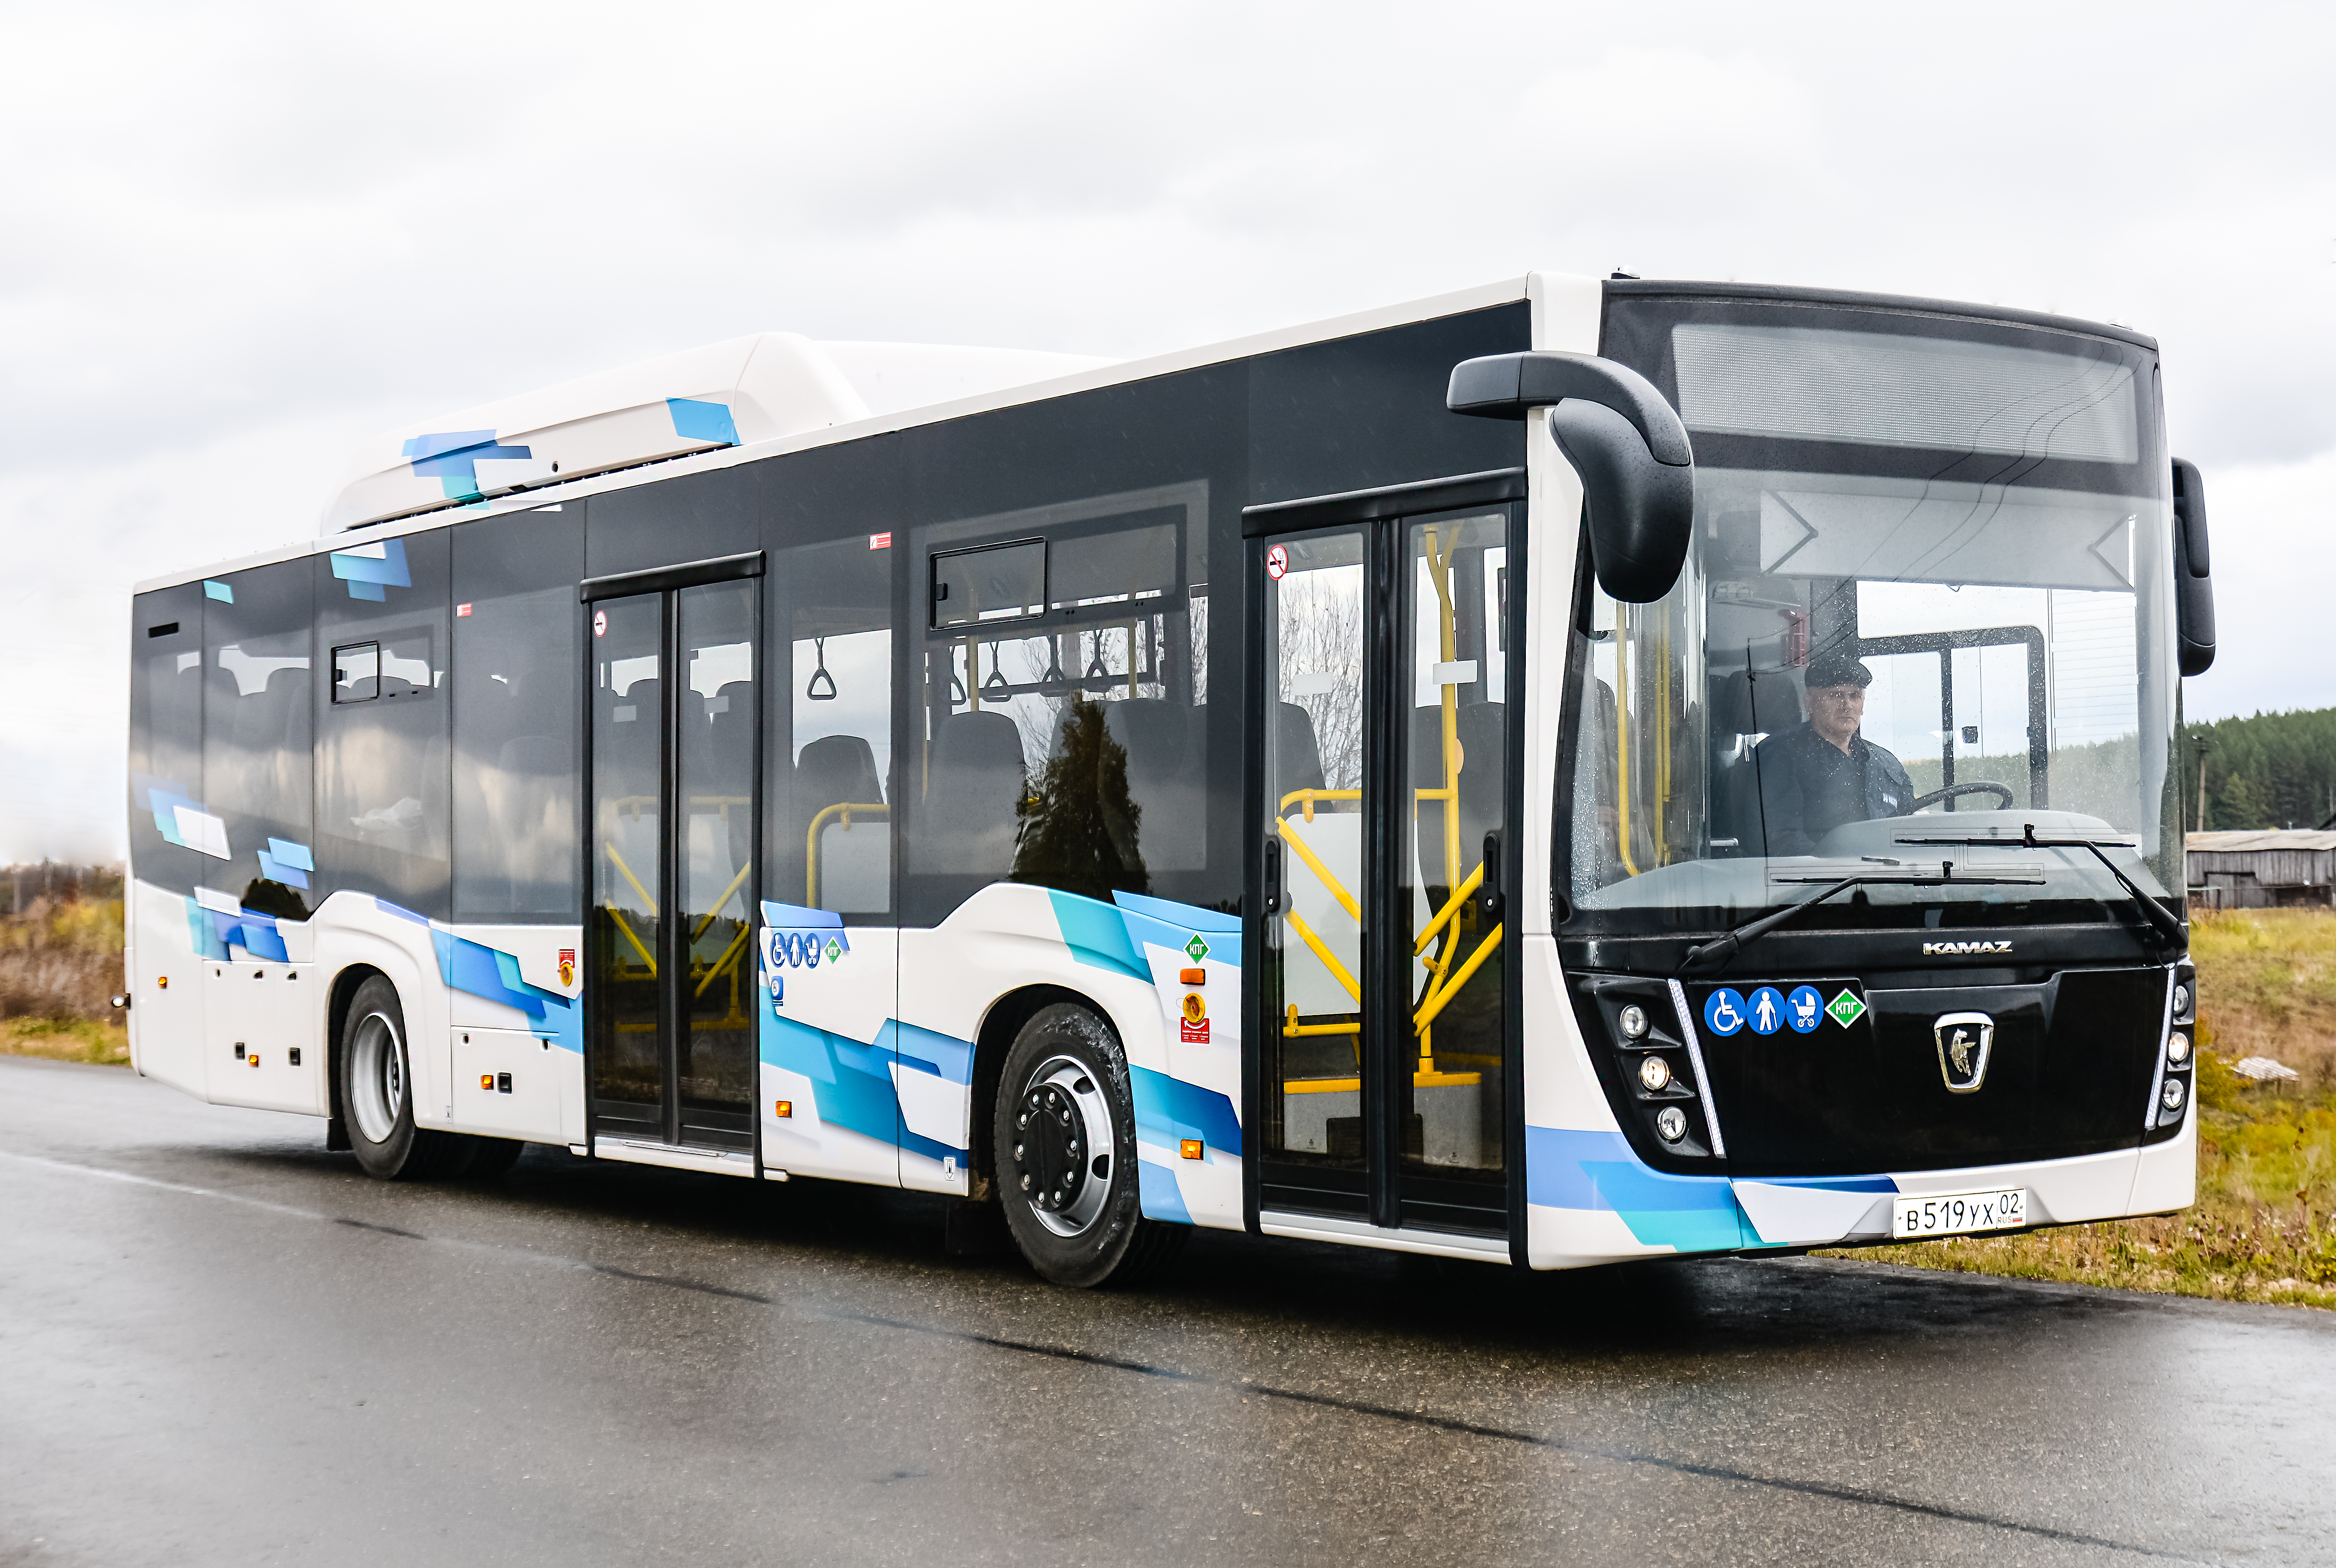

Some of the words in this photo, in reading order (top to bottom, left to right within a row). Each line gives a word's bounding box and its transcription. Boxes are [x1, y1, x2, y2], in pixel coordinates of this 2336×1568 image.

[827, 947, 838, 956] КПГ
[1190, 944, 1204, 955] КПГ
[1923, 940, 2013, 955] KAMAZ
[1835, 1001, 1858, 1015] КПГ
[2000, 1193, 2019, 1214] 02
[1998, 1216, 2012, 1224] RUS
